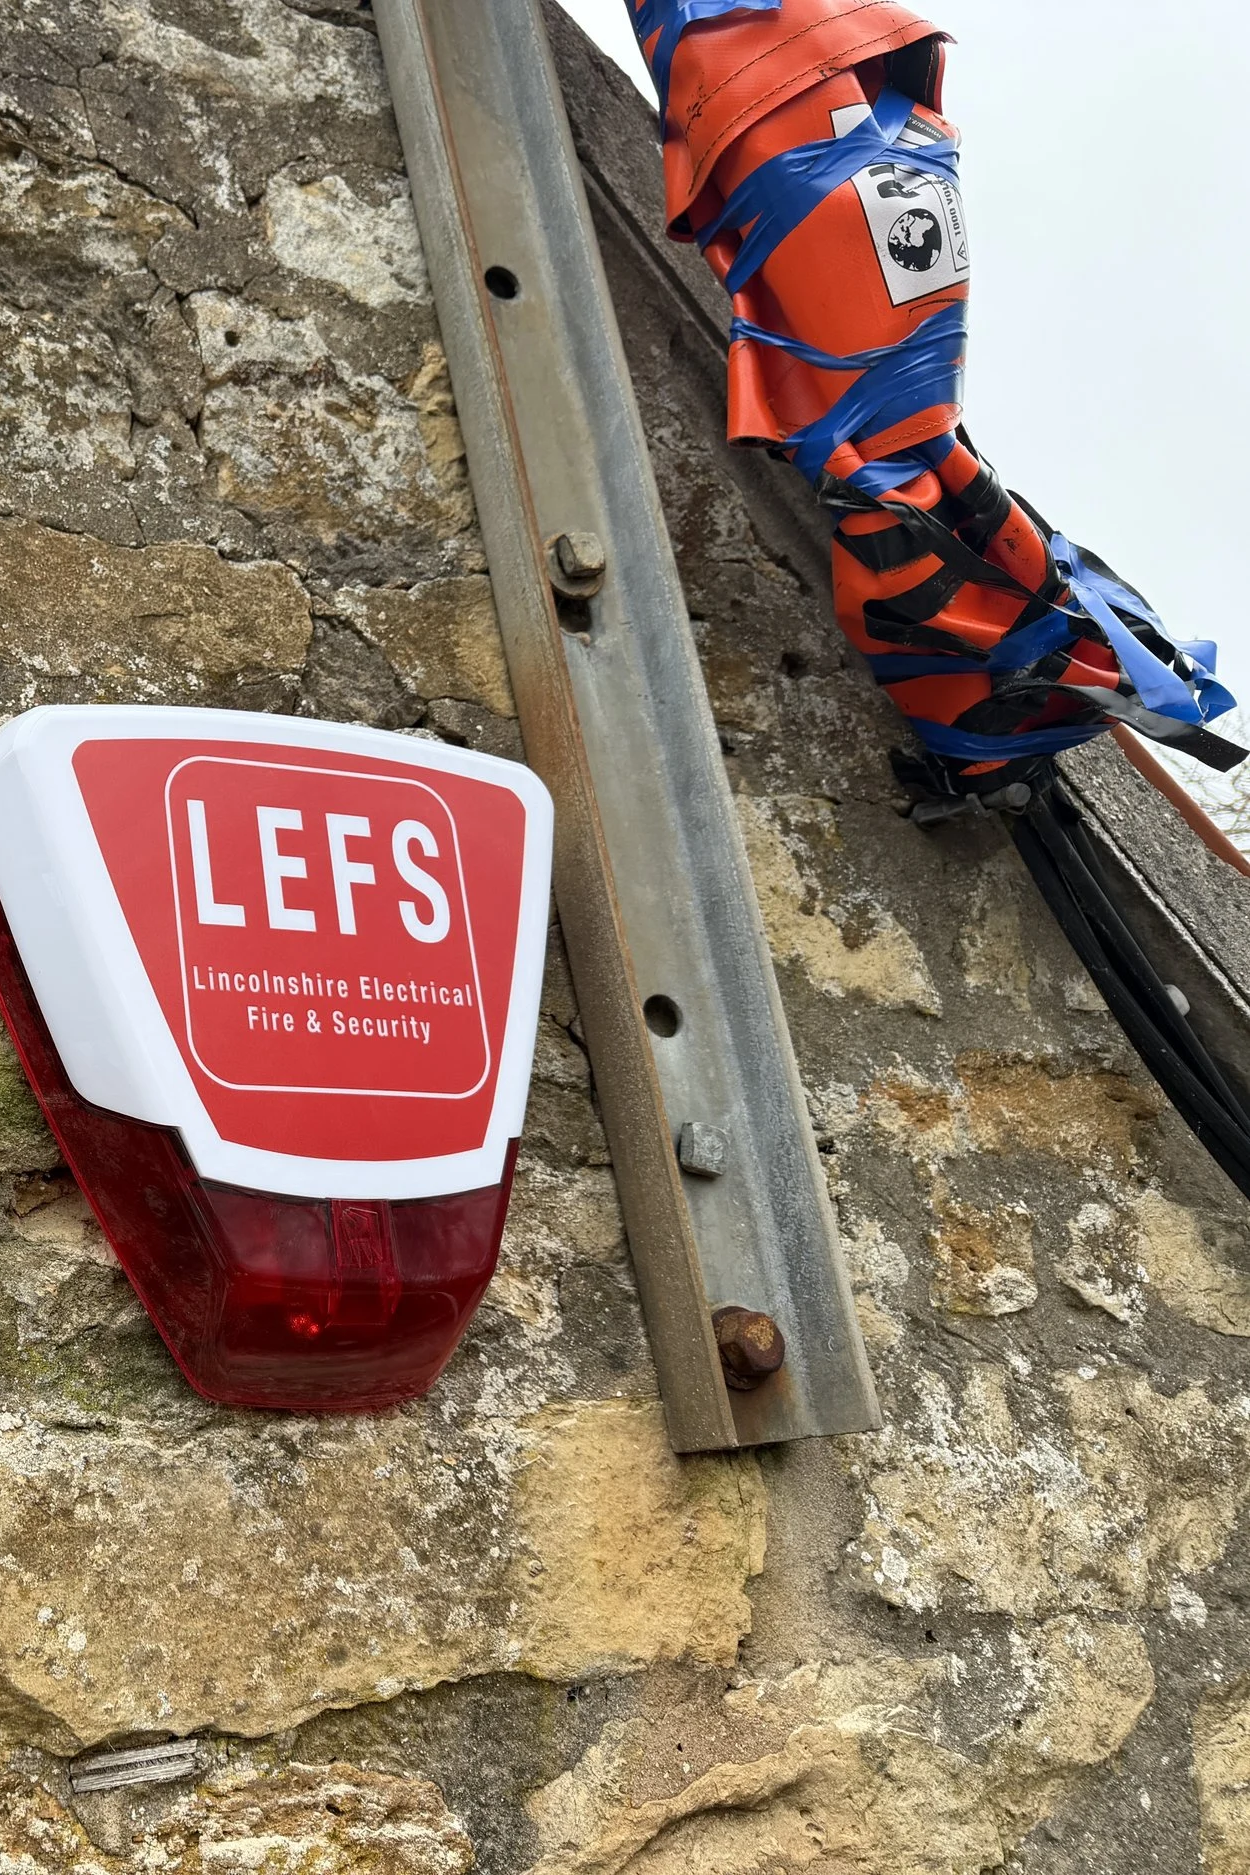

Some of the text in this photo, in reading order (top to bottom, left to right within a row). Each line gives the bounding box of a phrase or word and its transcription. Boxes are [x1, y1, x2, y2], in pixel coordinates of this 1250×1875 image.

[949, 207, 961, 236] 1000
[186, 799, 450, 944] LEFS
[193, 965, 473, 1007] Lincolnshire Electrical
[246, 1005, 432, 1044] Fire & Security
